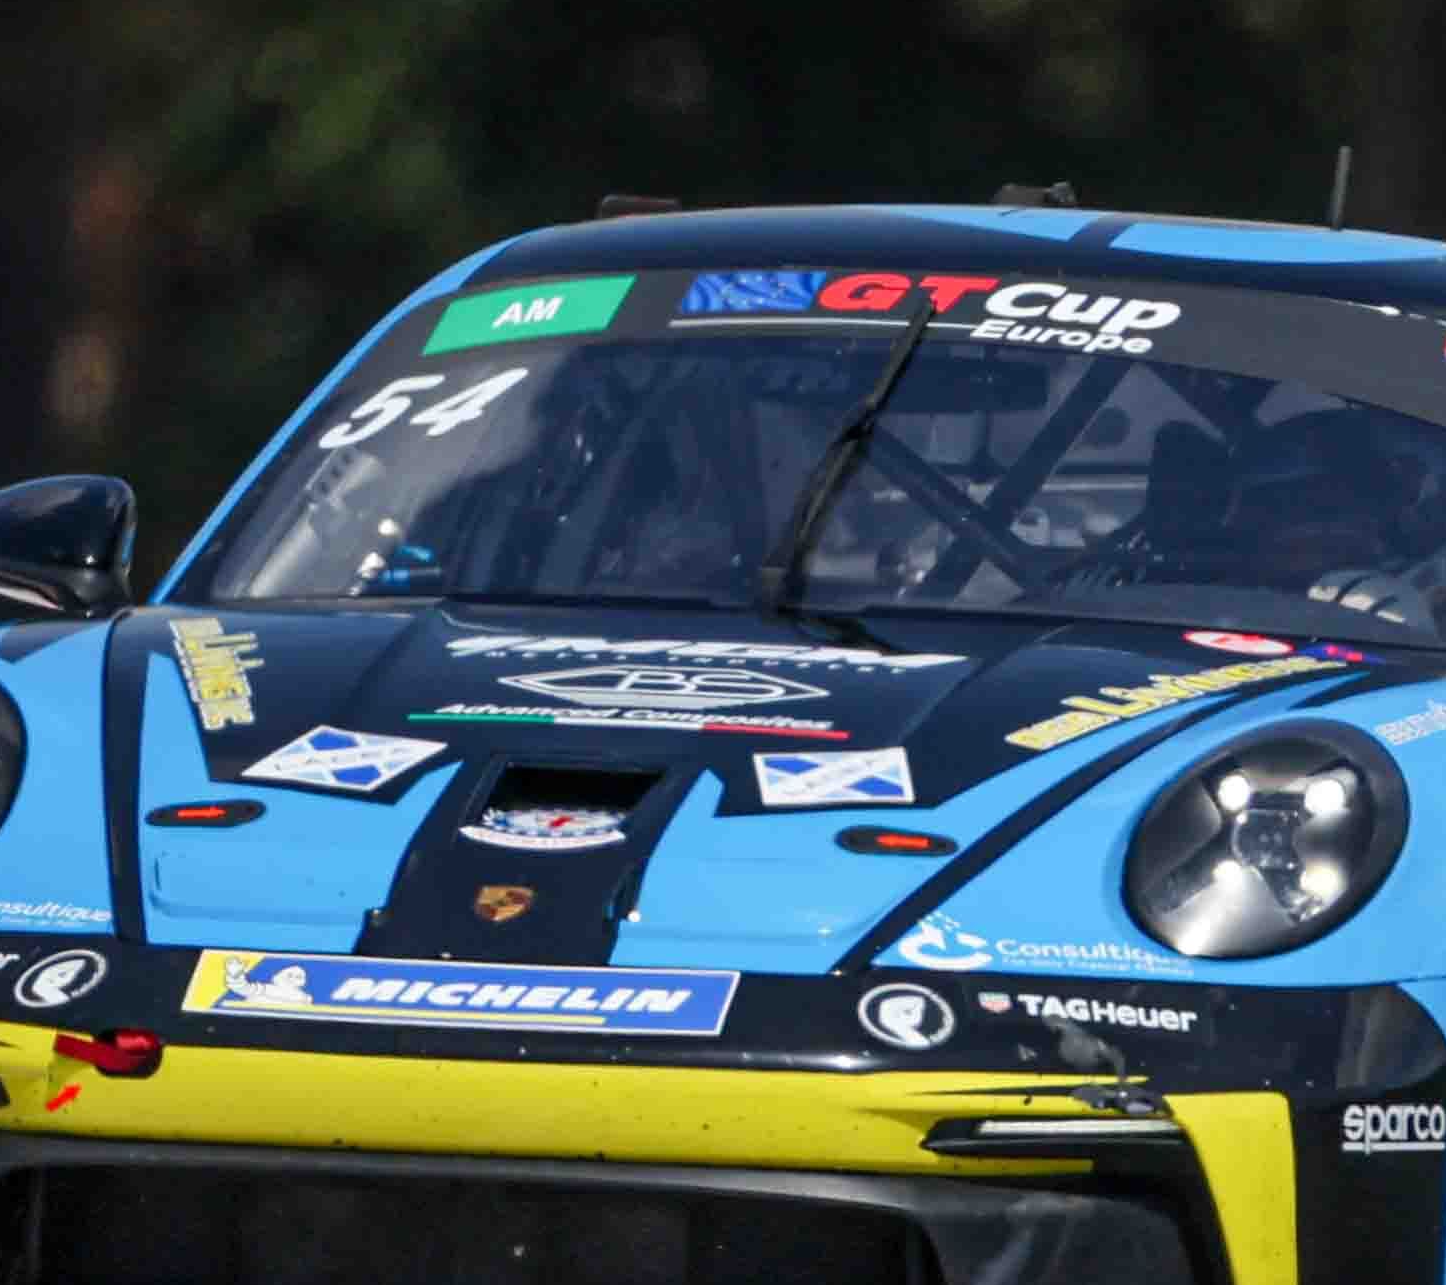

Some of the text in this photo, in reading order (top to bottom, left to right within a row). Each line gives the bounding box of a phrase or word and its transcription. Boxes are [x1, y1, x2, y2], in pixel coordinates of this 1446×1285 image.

[491, 296, 564, 328] AM
[970, 318, 1154, 354] Europe
[318, 367, 530, 449] 54
[436, 703, 835, 731] Advanced Composites
[331, 977, 693, 1014] MICHELIN
[1343, 1104, 1446, 1156] sparco
